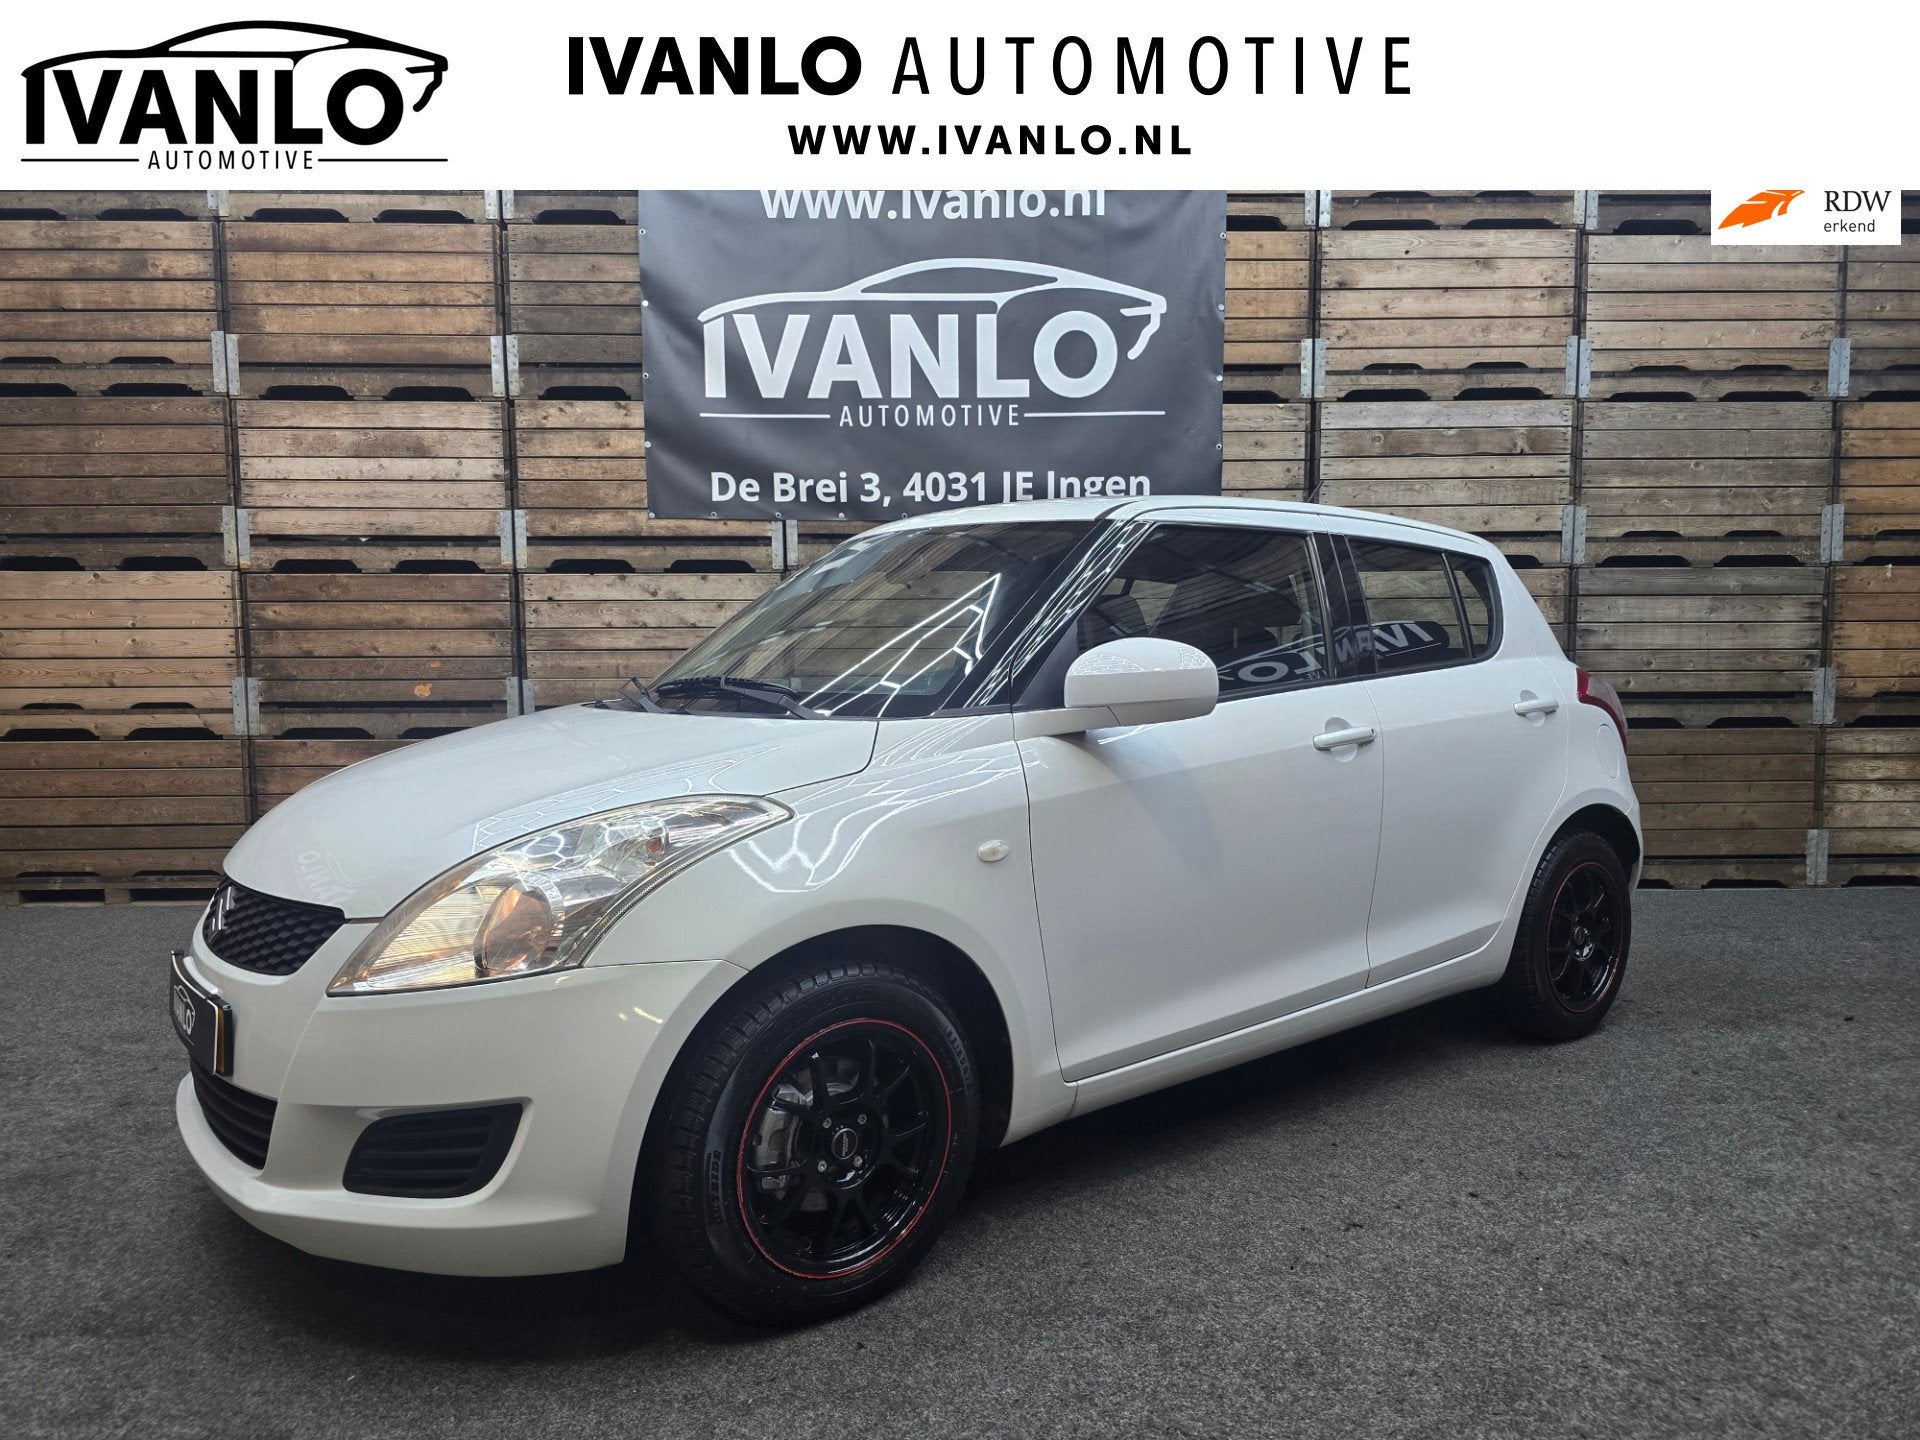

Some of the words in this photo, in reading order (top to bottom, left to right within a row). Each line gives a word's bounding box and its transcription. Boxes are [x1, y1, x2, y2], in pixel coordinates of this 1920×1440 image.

[703, 310, 1119, 399] IVANLO
[839, 404, 1020, 428] AUTOMOTIVE
[710, 471, 760, 502] De
[774, 470, 848, 503] Brei
[860, 471, 892, 507] 3,
[903, 470, 986, 502] 4031
[1002, 471, 1034, 503] JE
